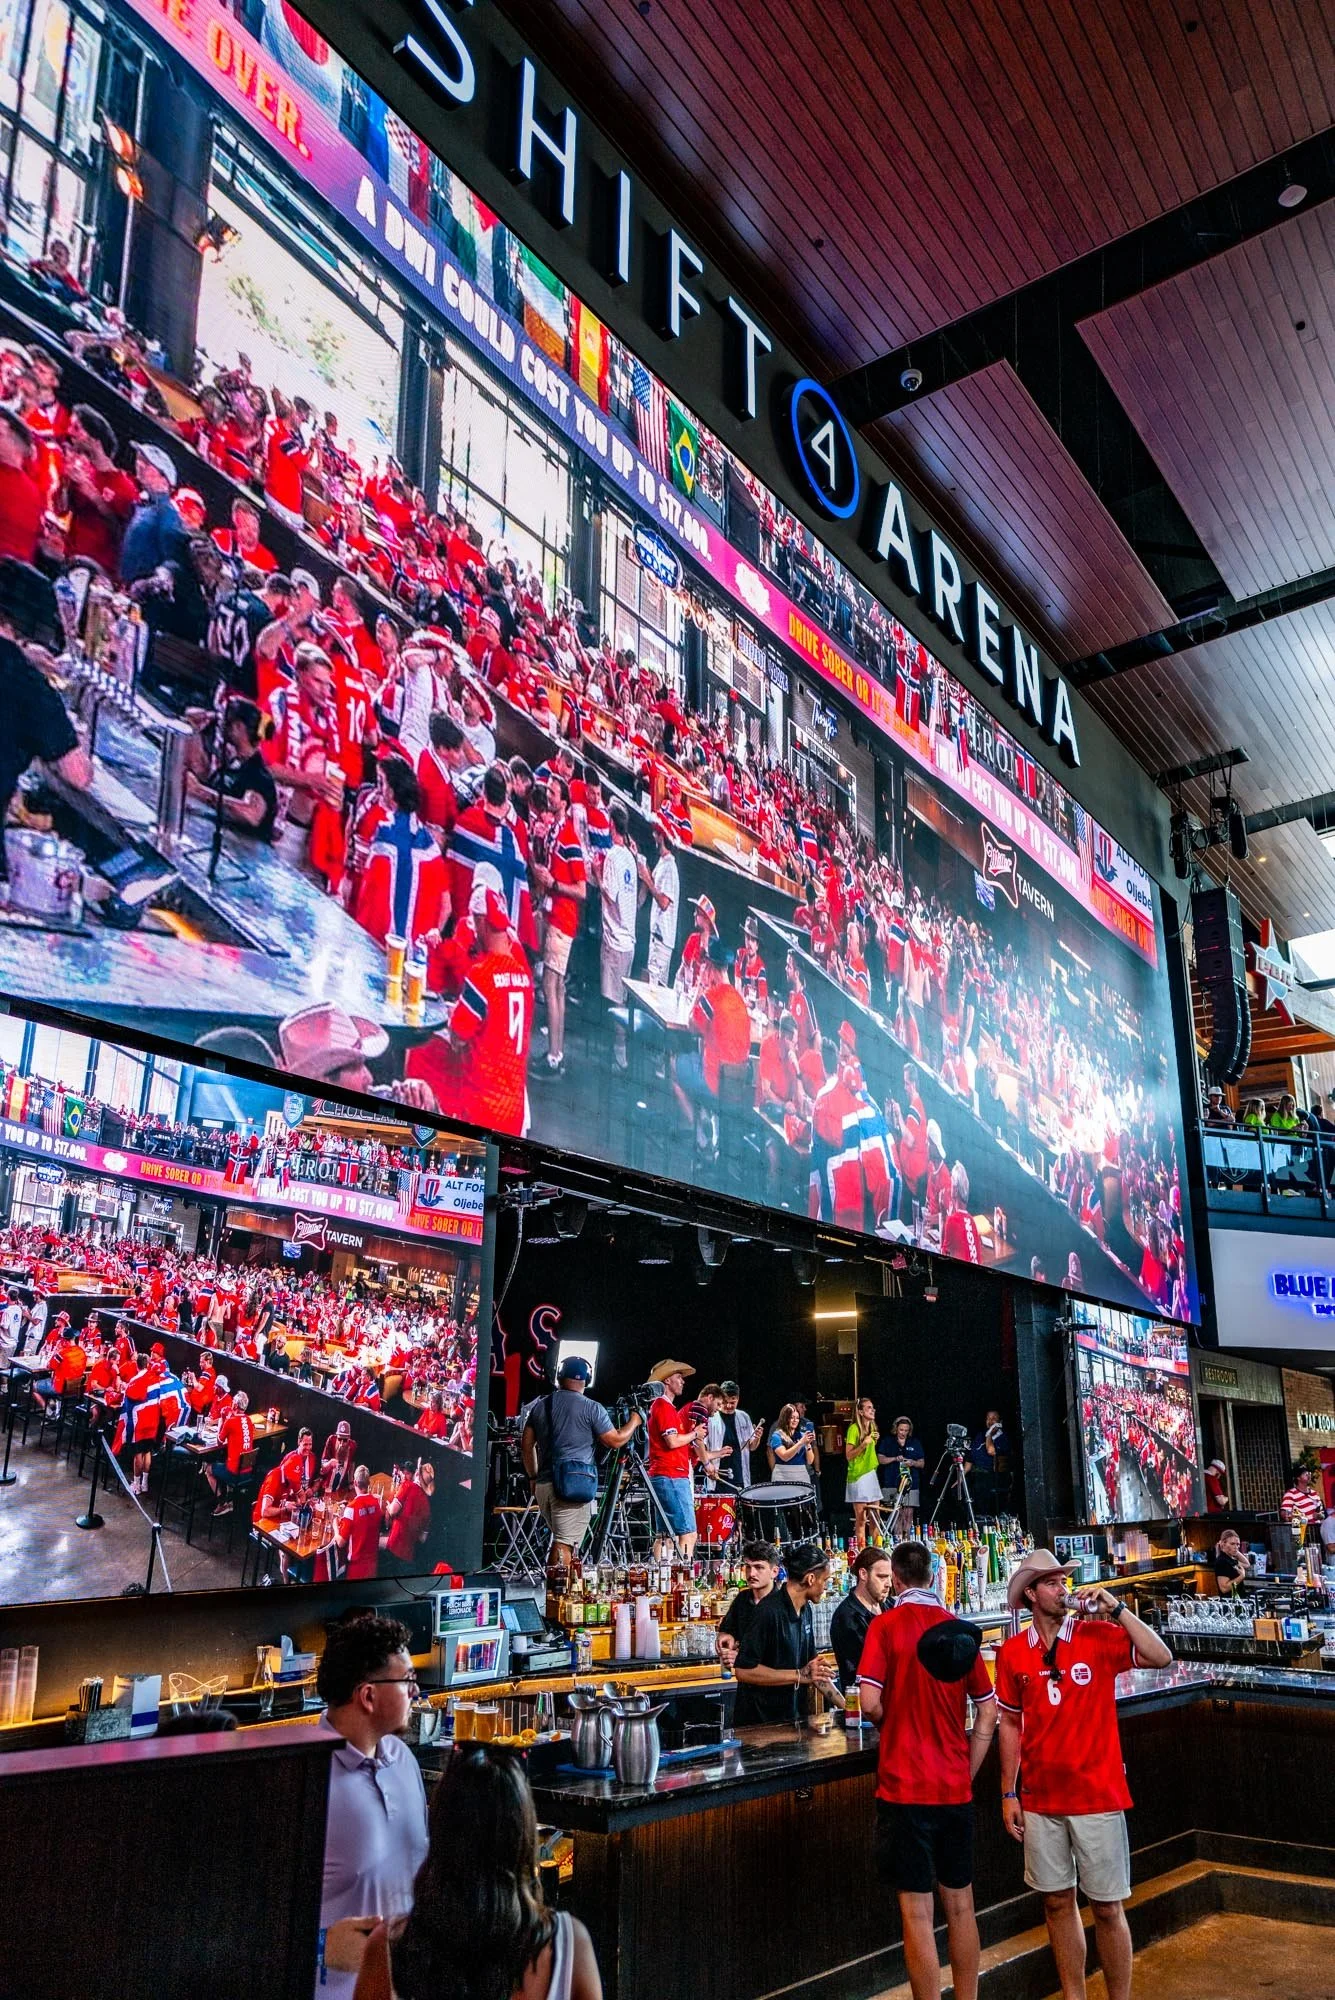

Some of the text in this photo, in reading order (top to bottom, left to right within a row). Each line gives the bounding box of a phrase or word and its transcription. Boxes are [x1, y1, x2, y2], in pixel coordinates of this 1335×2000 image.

[208, 18, 312, 161] OVER.
[356, 174, 377, 229] A
[385, 200, 436, 287] DWI
[443, 262, 516, 364] COULD
[521, 344, 570, 418] COST
[574, 395, 608, 457] YOU
[612, 435, 634, 480] UP
[637, 460, 656, 505] TO
[811, 420, 836, 491] 4
[877, 481, 1080, 766] ARENA
[788, 610, 820, 661] DRIVE
[821, 642, 854, 692] SOBER
[855, 674, 870, 705] OR
[1013, 806, 1027, 839] UP
[1029, 819, 1041, 853] TO
[1017, 873, 1055, 922] TAVERN
[1112, 901, 1137, 942] SOBER
[5, 1123, 88, 1162] YOU UP TO $17,000.
[140, 1161, 164, 1178] DRIVE
[165, 1166, 189, 1183] SOBER
[192, 1173, 203, 1185] OR
[445, 1180, 464, 1190] ALT
[312, 1190, 329, 1209] YOU
[330, 1194, 343, 1213] UP
[345, 1197, 357, 1213] TO
[360, 1199, 396, 1222] $17,000.
[454, 1198, 484, 1210] Oljebe
[326, 1230, 363, 1248] TAVERN
[432, 1216, 459, 1235] SOBER
[462, 1222, 473, 1237] OR
[1273, 1273, 1330, 1298] BLUE
[1204, 1367, 1236, 1385] RESTROOMS
[240, 1415, 251, 1450] NORGE
[1047, 1678, 1061, 1706] 6
